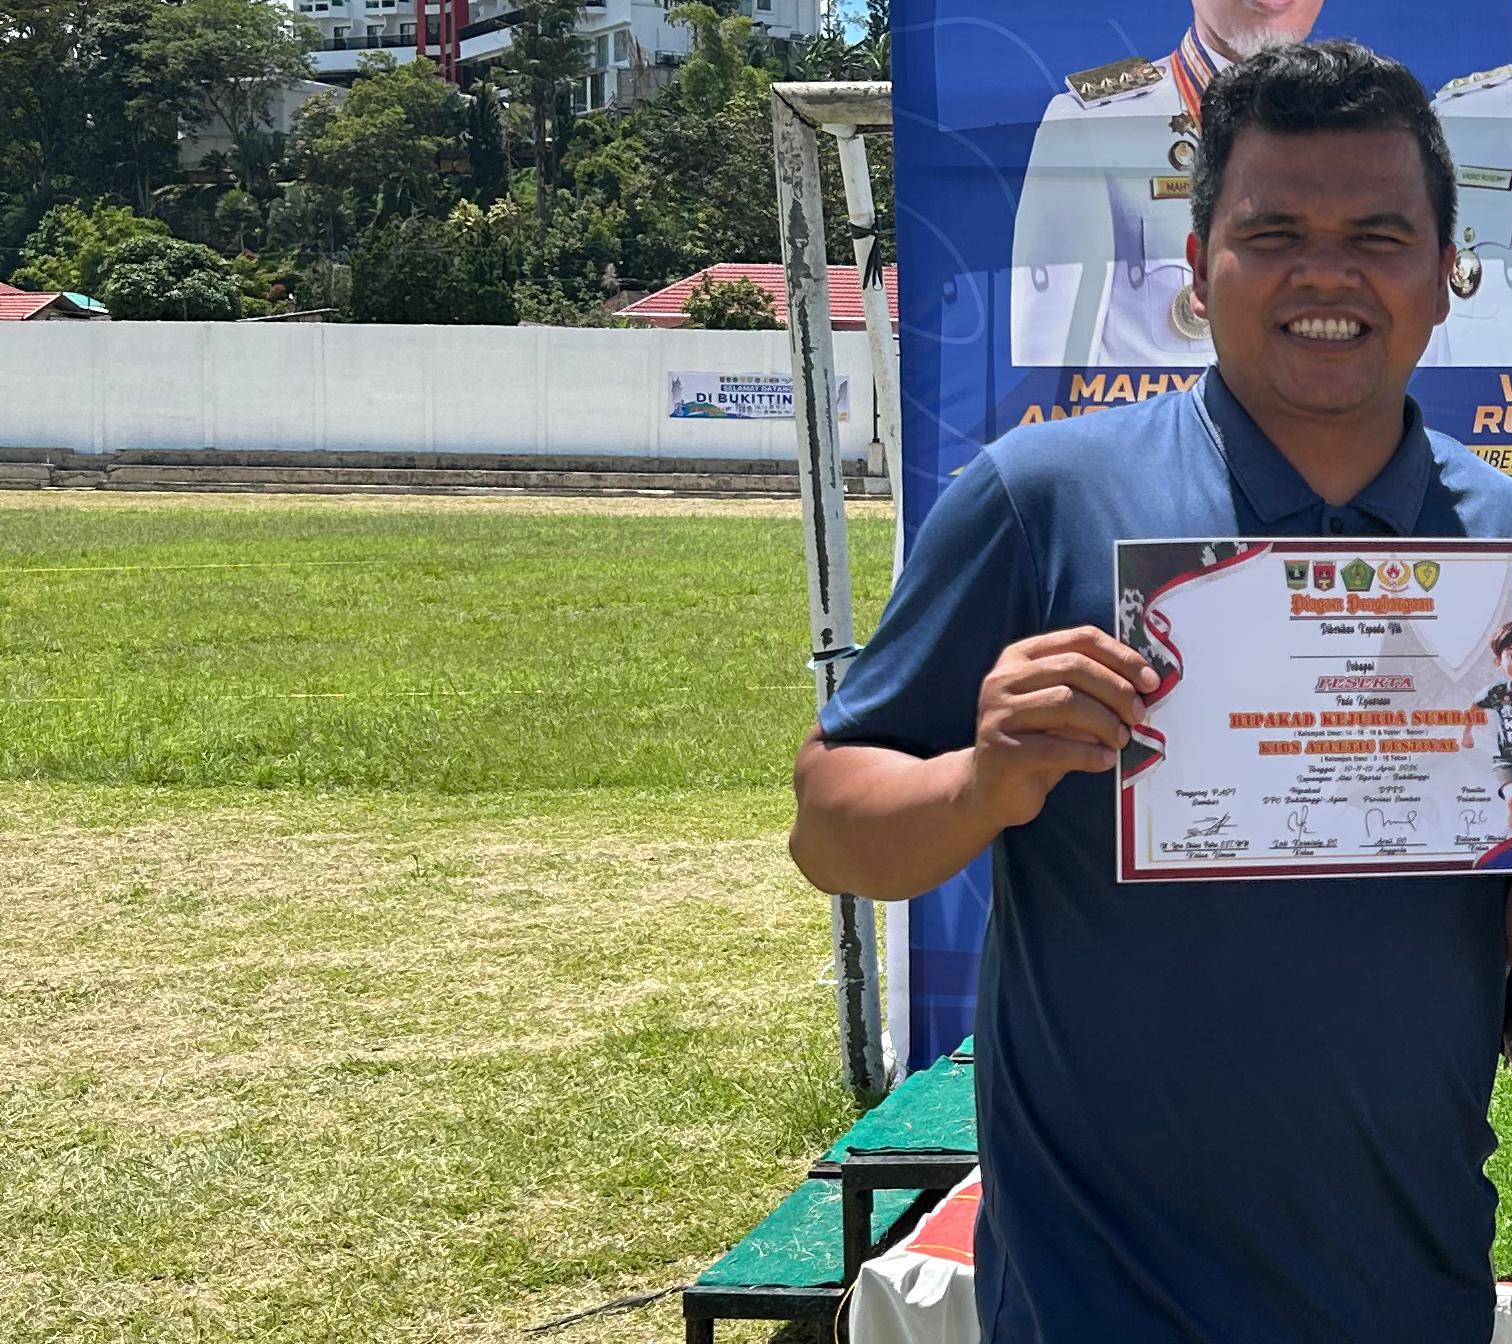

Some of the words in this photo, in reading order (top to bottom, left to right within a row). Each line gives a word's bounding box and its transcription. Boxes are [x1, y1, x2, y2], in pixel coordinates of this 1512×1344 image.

[696, 392, 713, 403] DI
[1315, 675, 1414, 691] PESERTA
[1229, 711, 1317, 729] HIPAKAD
[1320, 710, 1408, 727] KEJURDA
[1411, 709, 1489, 726] SUMBAR
[1258, 740, 1303, 756] KIDS
